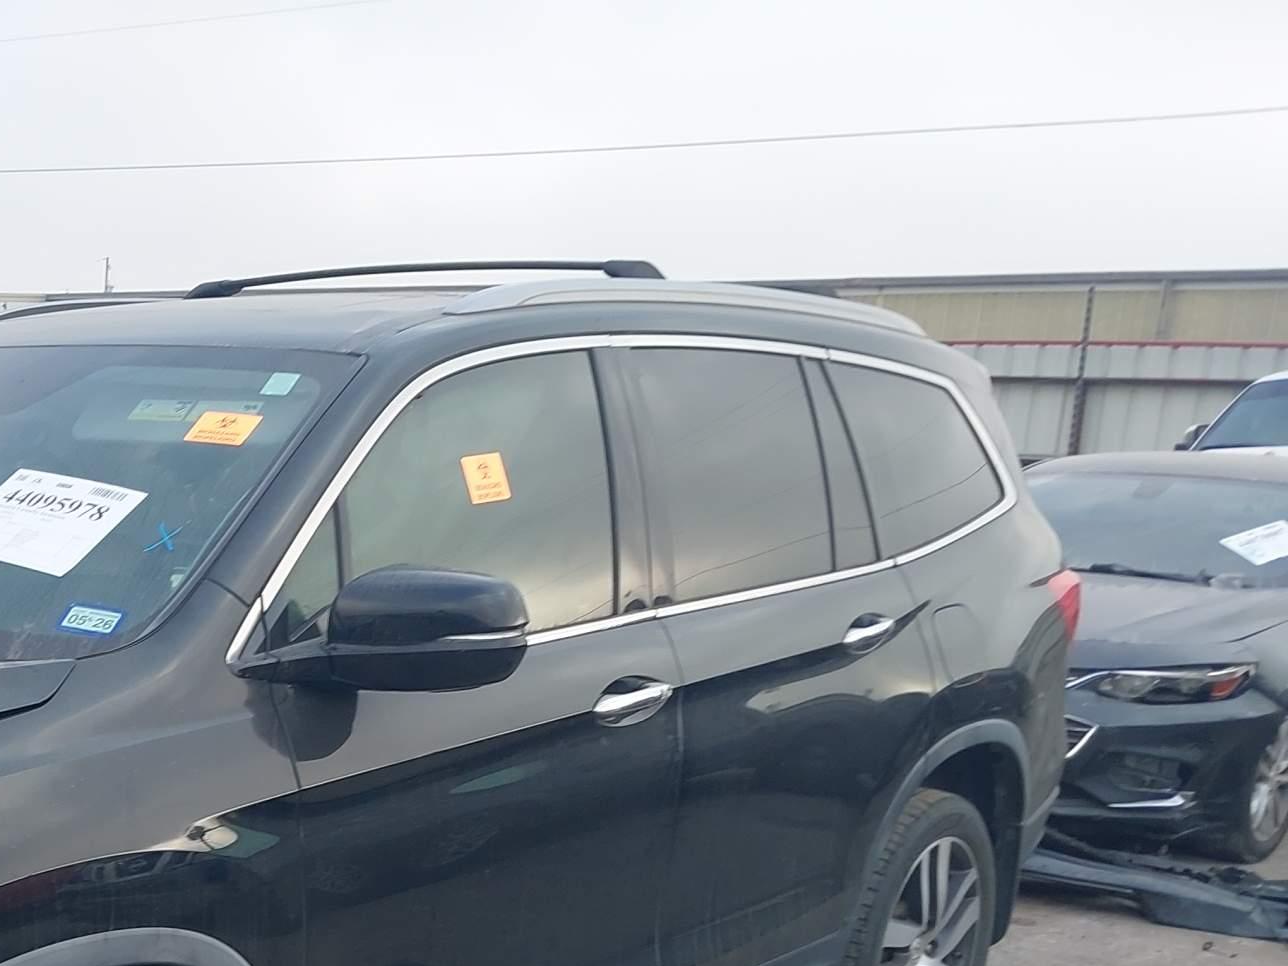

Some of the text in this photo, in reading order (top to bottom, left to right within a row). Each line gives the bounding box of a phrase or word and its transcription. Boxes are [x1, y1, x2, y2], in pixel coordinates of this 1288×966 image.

[3, 488, 110, 521] 44095978
[67, 614, 88, 625] 05
[92, 618, 114, 630] 26
